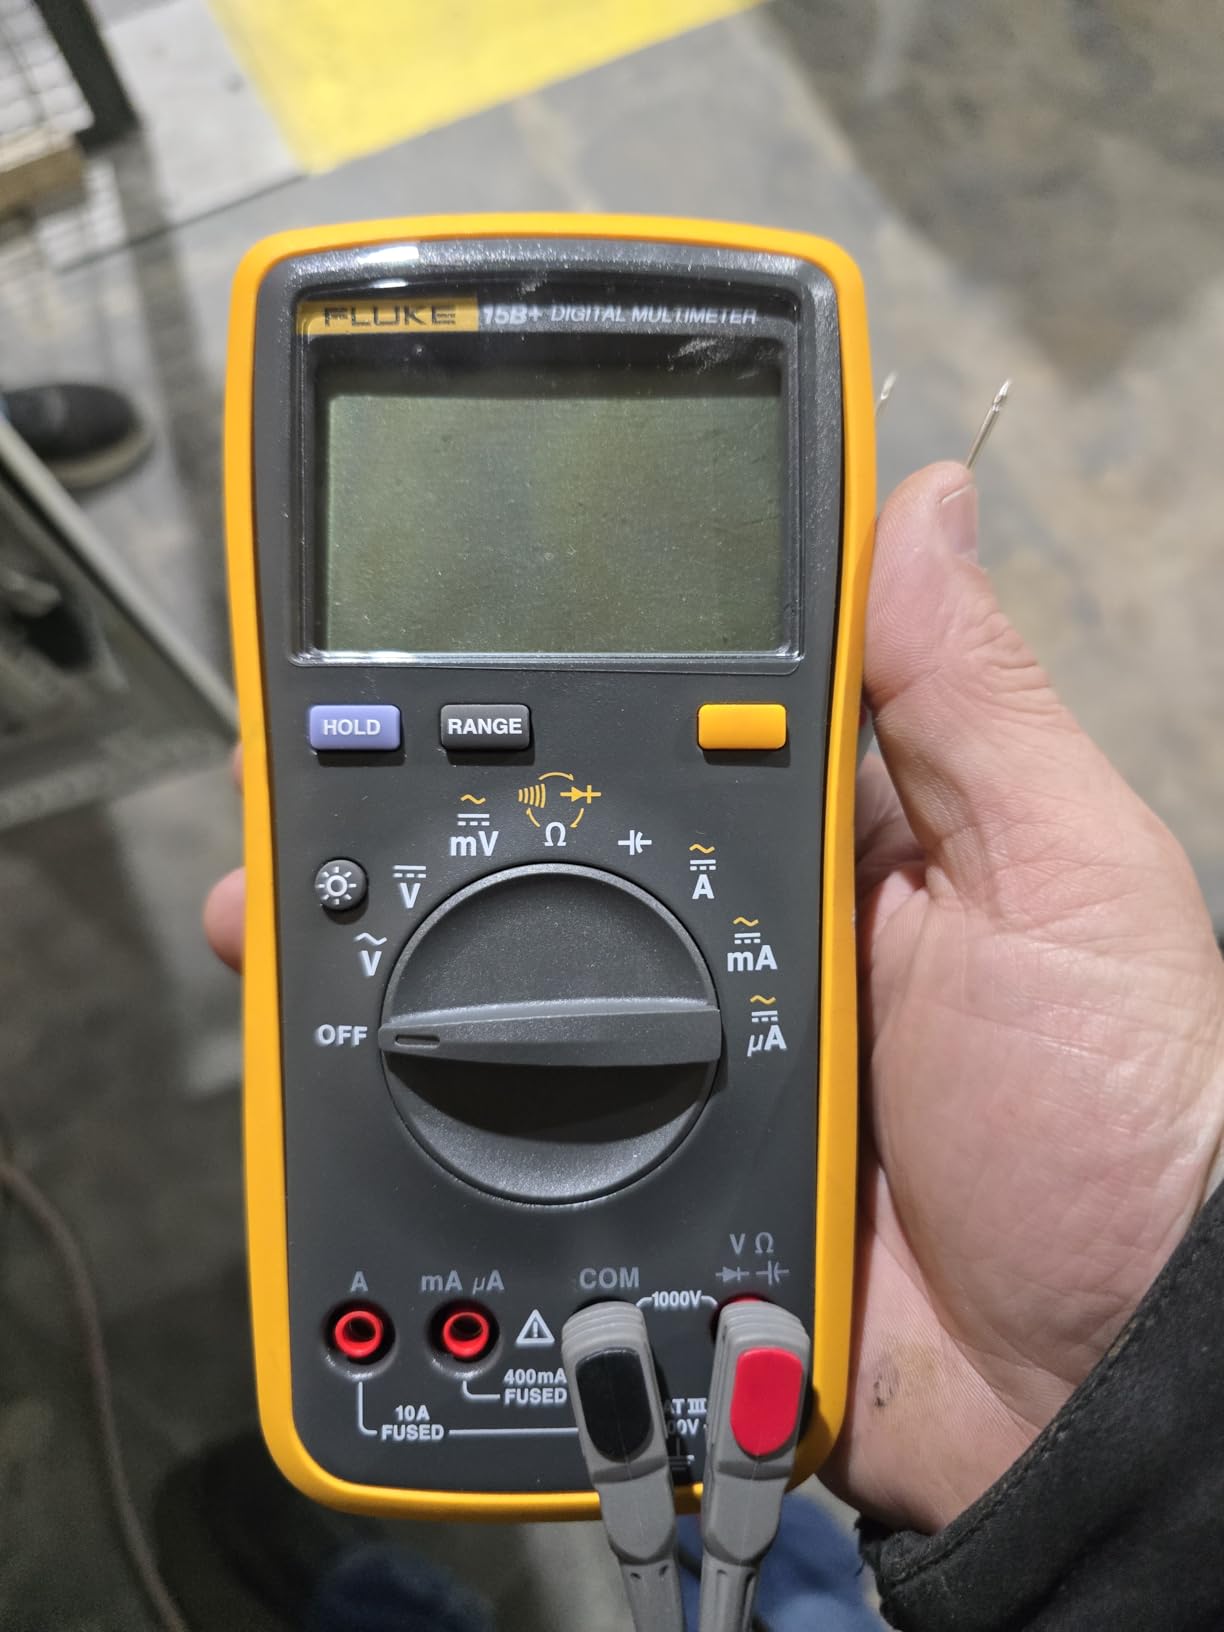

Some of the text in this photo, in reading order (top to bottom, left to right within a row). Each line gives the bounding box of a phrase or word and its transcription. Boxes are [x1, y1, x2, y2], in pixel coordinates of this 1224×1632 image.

[324, 304, 757, 328] FLUKE 15B+ DIGITAL MULTIMETER
[323, 718, 381, 736] HOLD
[447, 717, 523, 736] RANGE
[450, 831, 499, 857] mV
[400, 881, 421, 908] V
[692, 873, 715, 899] A
[360, 951, 383, 977] V
[726, 944, 777, 971] mA
[317, 1024, 368, 1048] OFF
[729, 1233, 746, 1254] V
[350, 1270, 369, 1292] A
[421, 1269, 463, 1292] mA
[579, 1267, 639, 1290] COM
[651, 1290, 702, 1307] 1000V
[503, 1367, 567, 1386] 400mA
[503, 1387, 568, 1406] FUSED
[395, 1404, 430, 1422] 10A
[381, 1424, 445, 1441] FUSED
